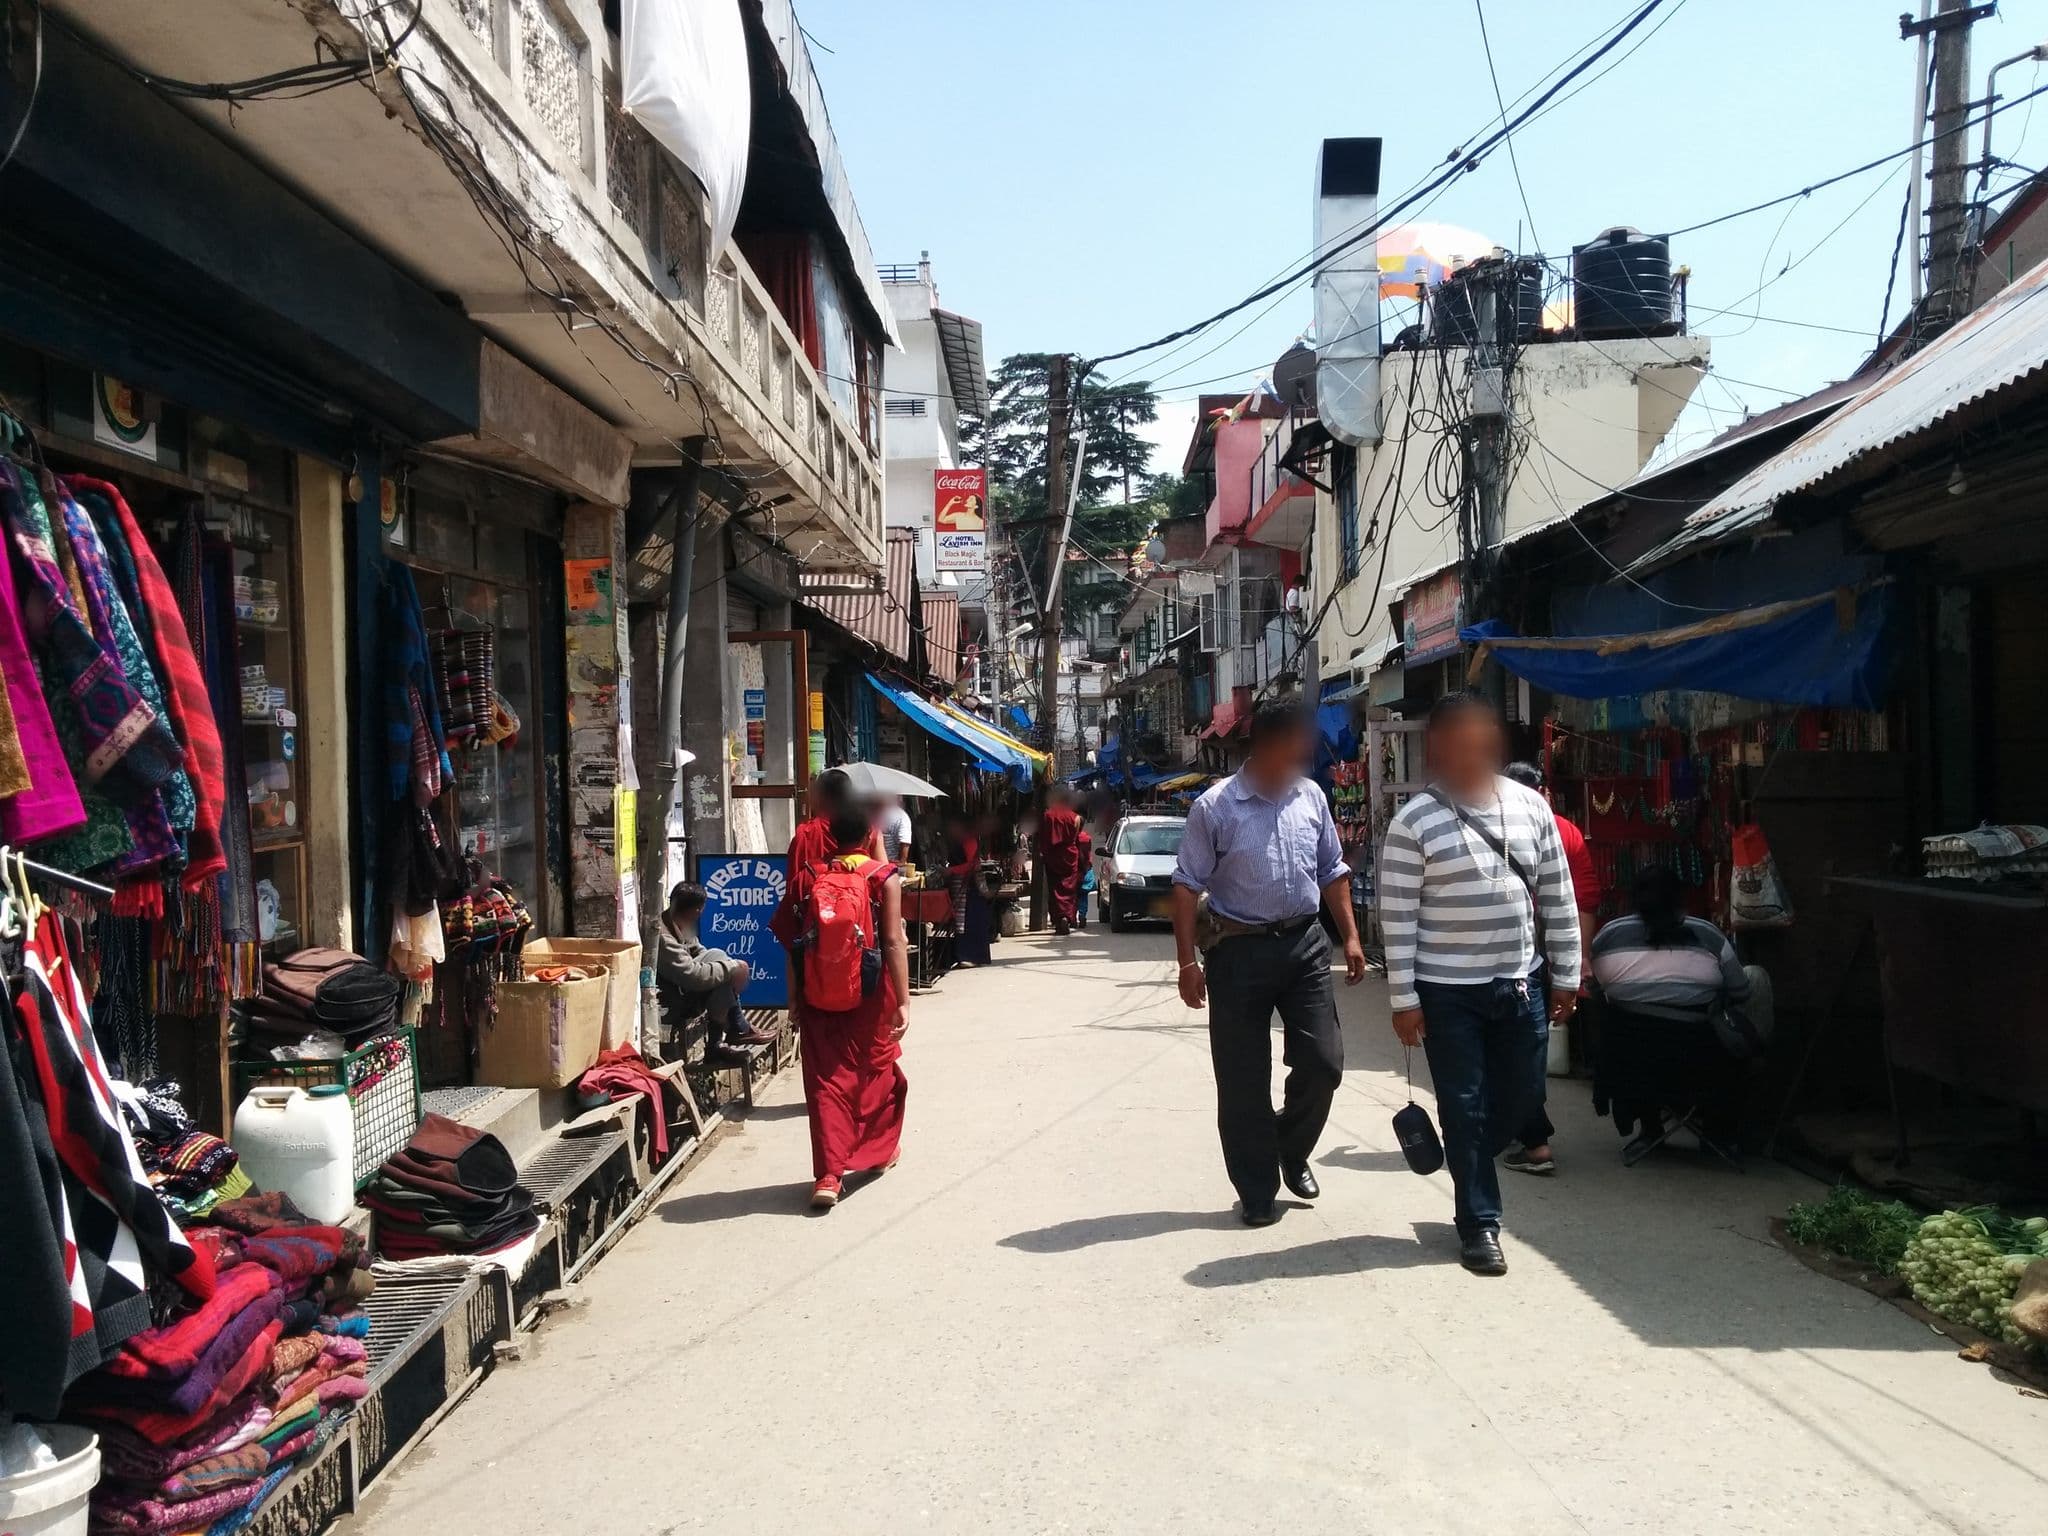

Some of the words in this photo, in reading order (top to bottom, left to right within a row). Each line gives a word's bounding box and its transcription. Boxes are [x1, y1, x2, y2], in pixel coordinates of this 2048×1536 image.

[937, 475, 982, 490] Coca-Cola
[939, 535, 969, 548] LAVISH
[704, 859, 752, 900] TIBET
[754, 861, 787, 902] BOO
[721, 888, 774, 906] STORE
[709, 912, 759, 933] Books
[727, 935, 755, 955] all
